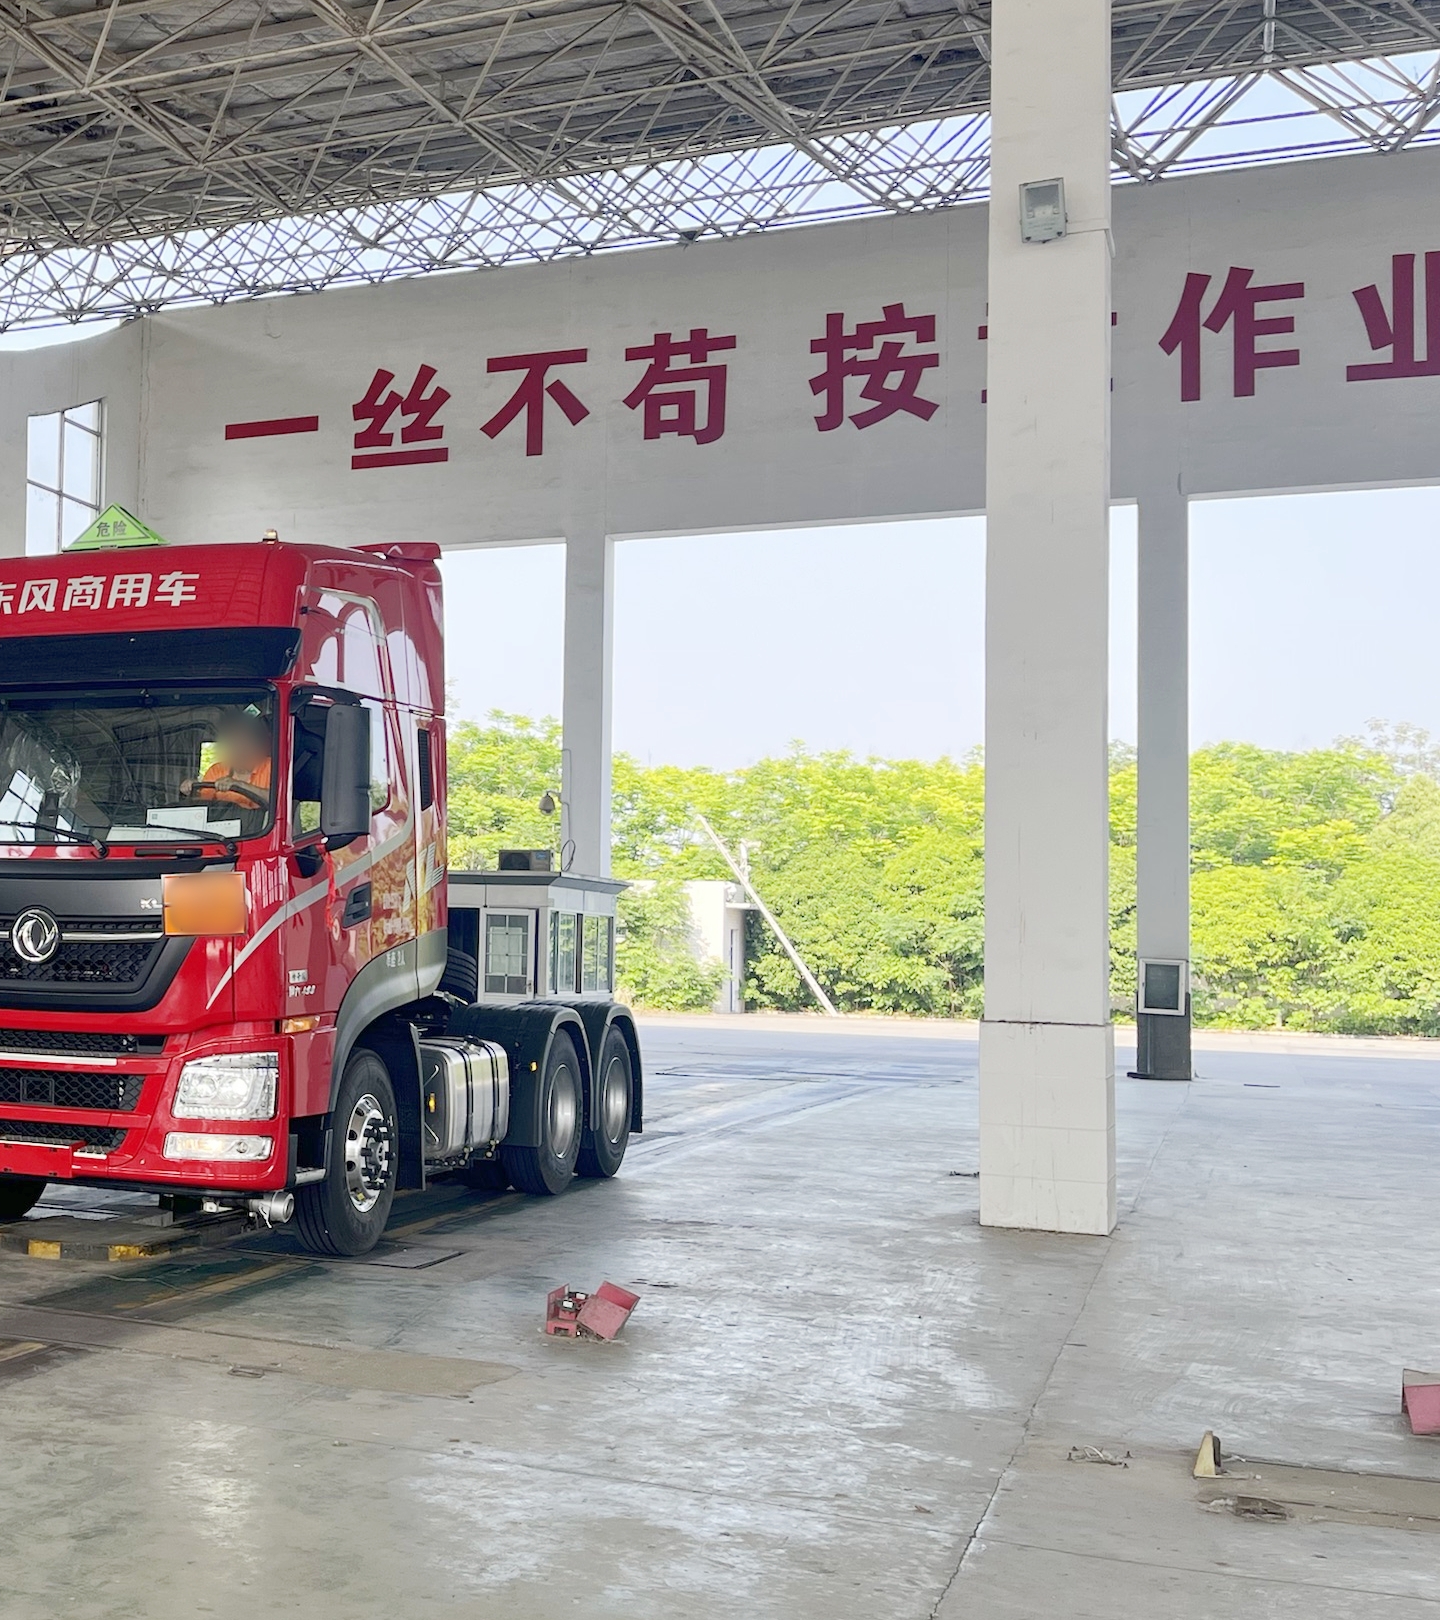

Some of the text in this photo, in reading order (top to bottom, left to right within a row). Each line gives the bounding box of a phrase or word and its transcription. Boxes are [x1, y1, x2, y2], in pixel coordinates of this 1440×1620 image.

[225, 250, 1440, 470] 一丝不苟 按作业
[96, 519, 127, 538] 危险
